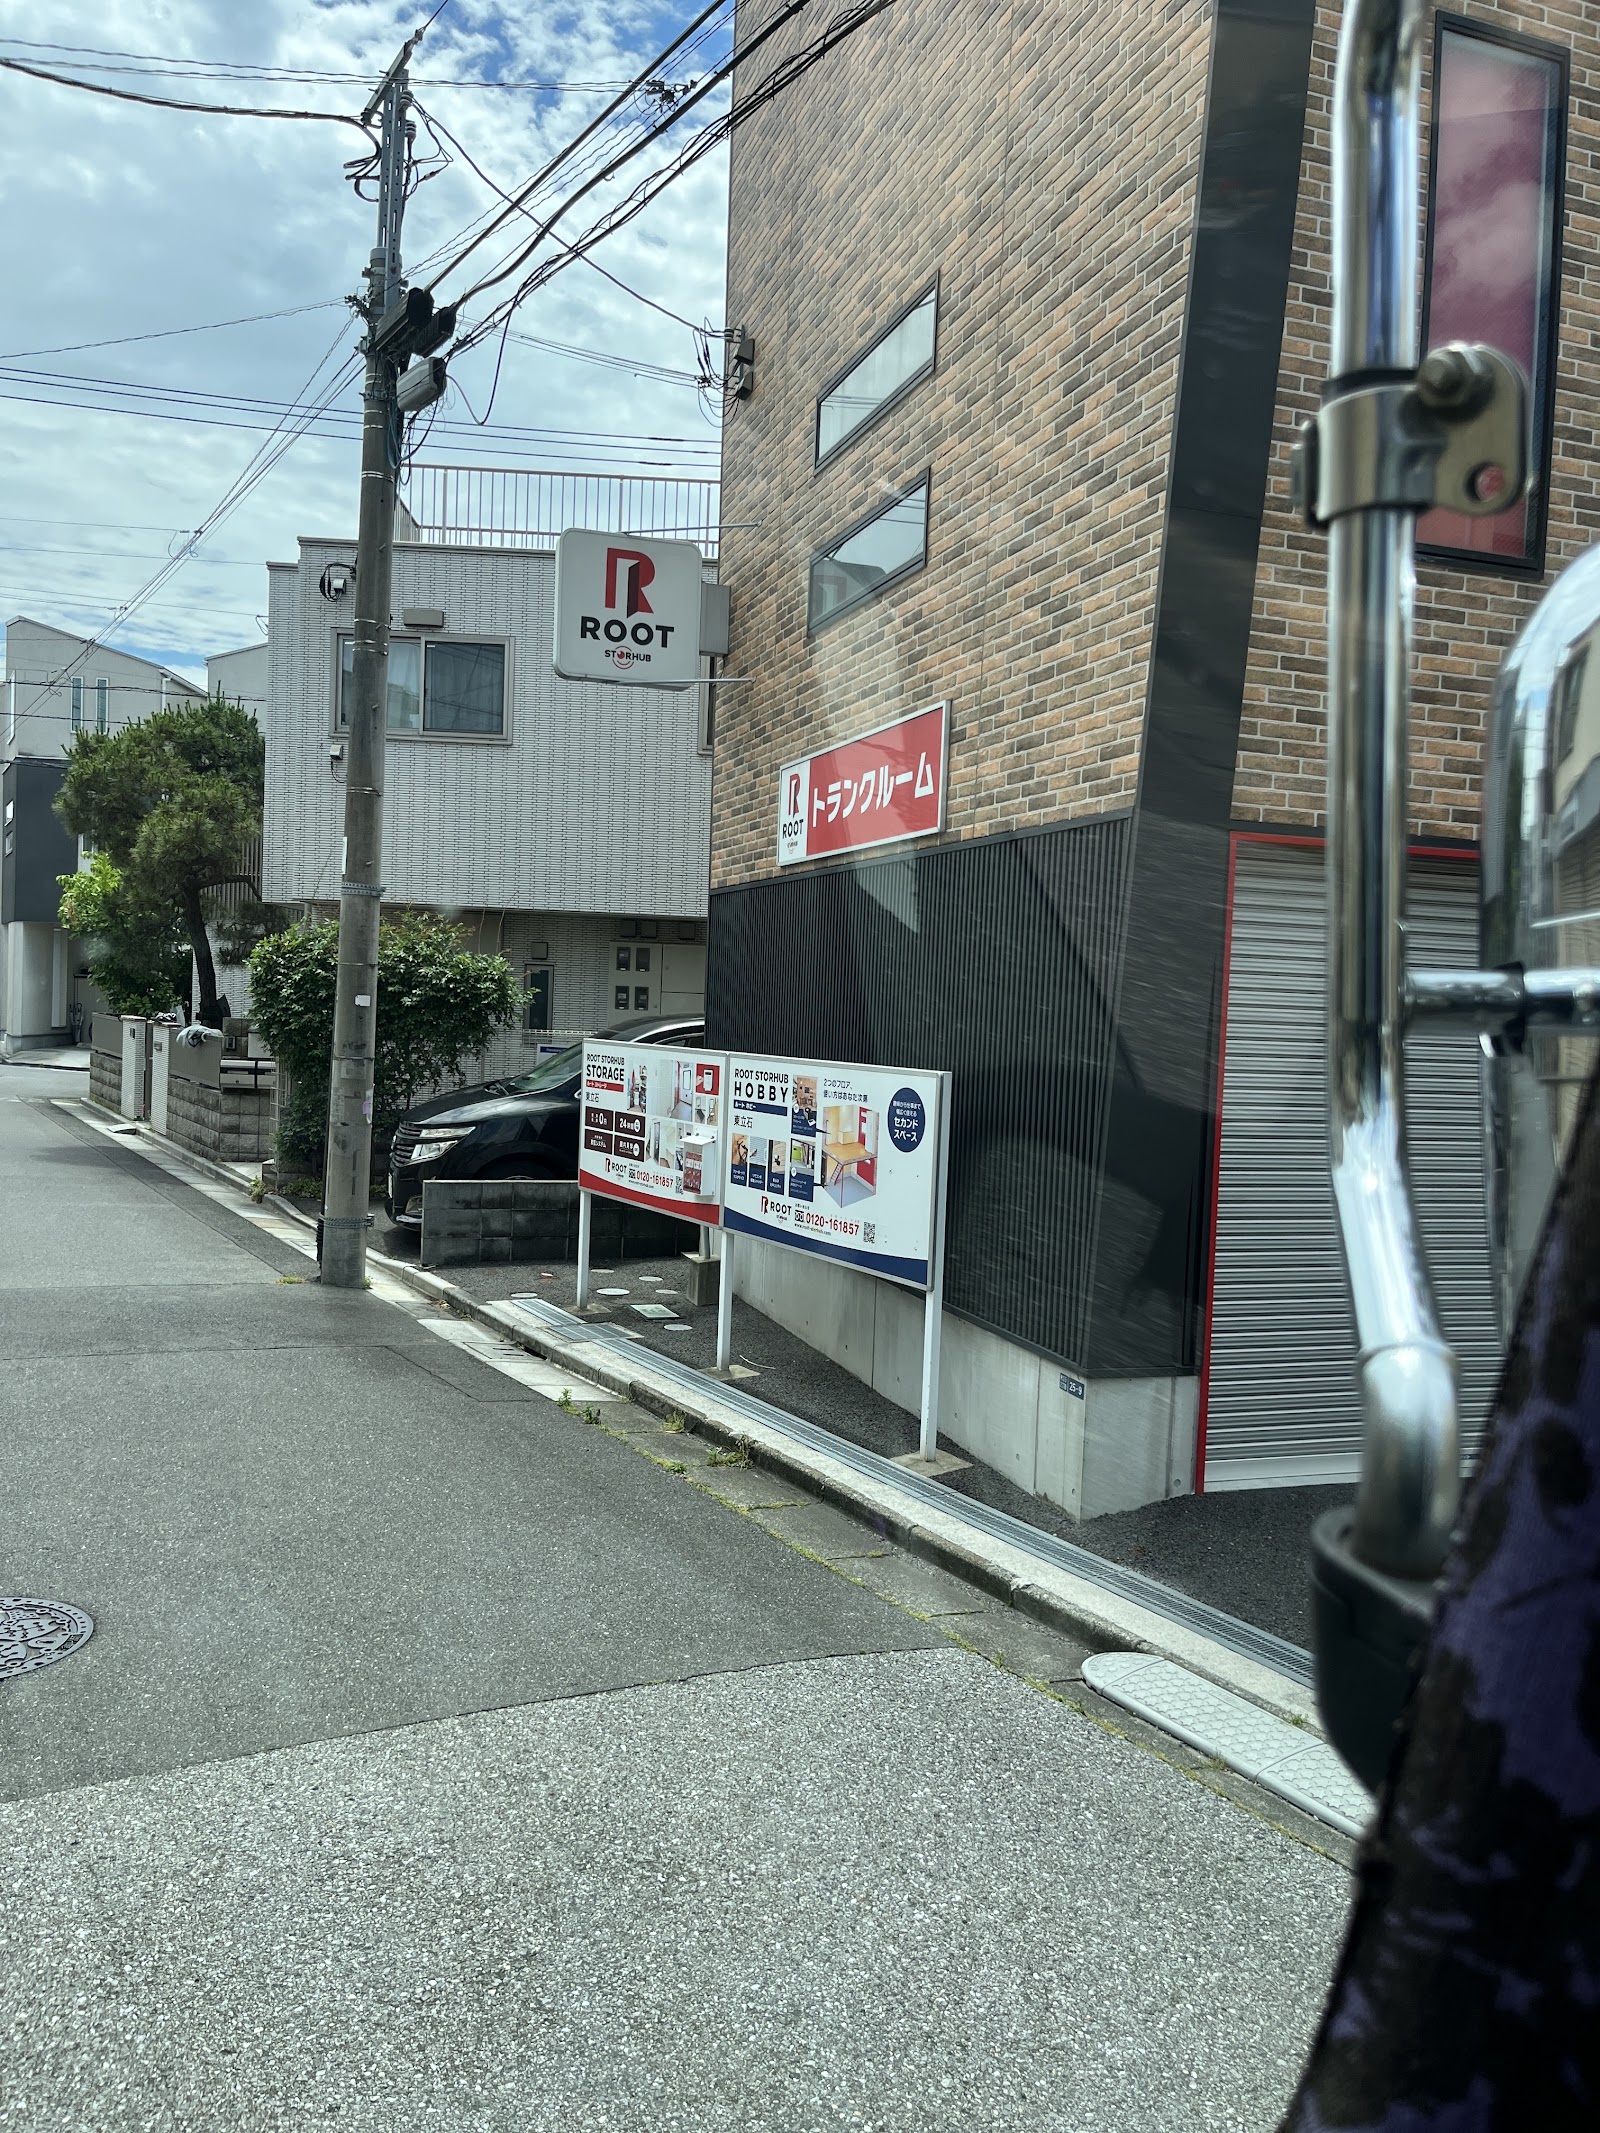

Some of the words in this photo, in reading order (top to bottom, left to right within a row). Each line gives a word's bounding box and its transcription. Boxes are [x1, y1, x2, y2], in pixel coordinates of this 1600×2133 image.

[580, 616, 675, 648] ROOT
[812, 752, 934, 828] トランクルーム
[782, 819, 804, 839] ROOT
[586, 1053, 601, 1063] ROOT
[601, 1055, 625, 1066] STORHUB
[586, 1064, 625, 1082] STORAGE
[734, 1068, 754, 1080] ROOT
[755, 1070, 789, 1084] STORHUB
[734, 1080, 789, 1103] HOBBY
[733, 1115, 753, 1129] 東立石
[894, 1116, 919, 1129] セカンド
[893, 1129, 917, 1142] スペース
[611, 1162, 627, 1174] ROOT
[770, 1201, 792, 1215] ROOT
[806, 1212, 860, 1235] 0120-161857
